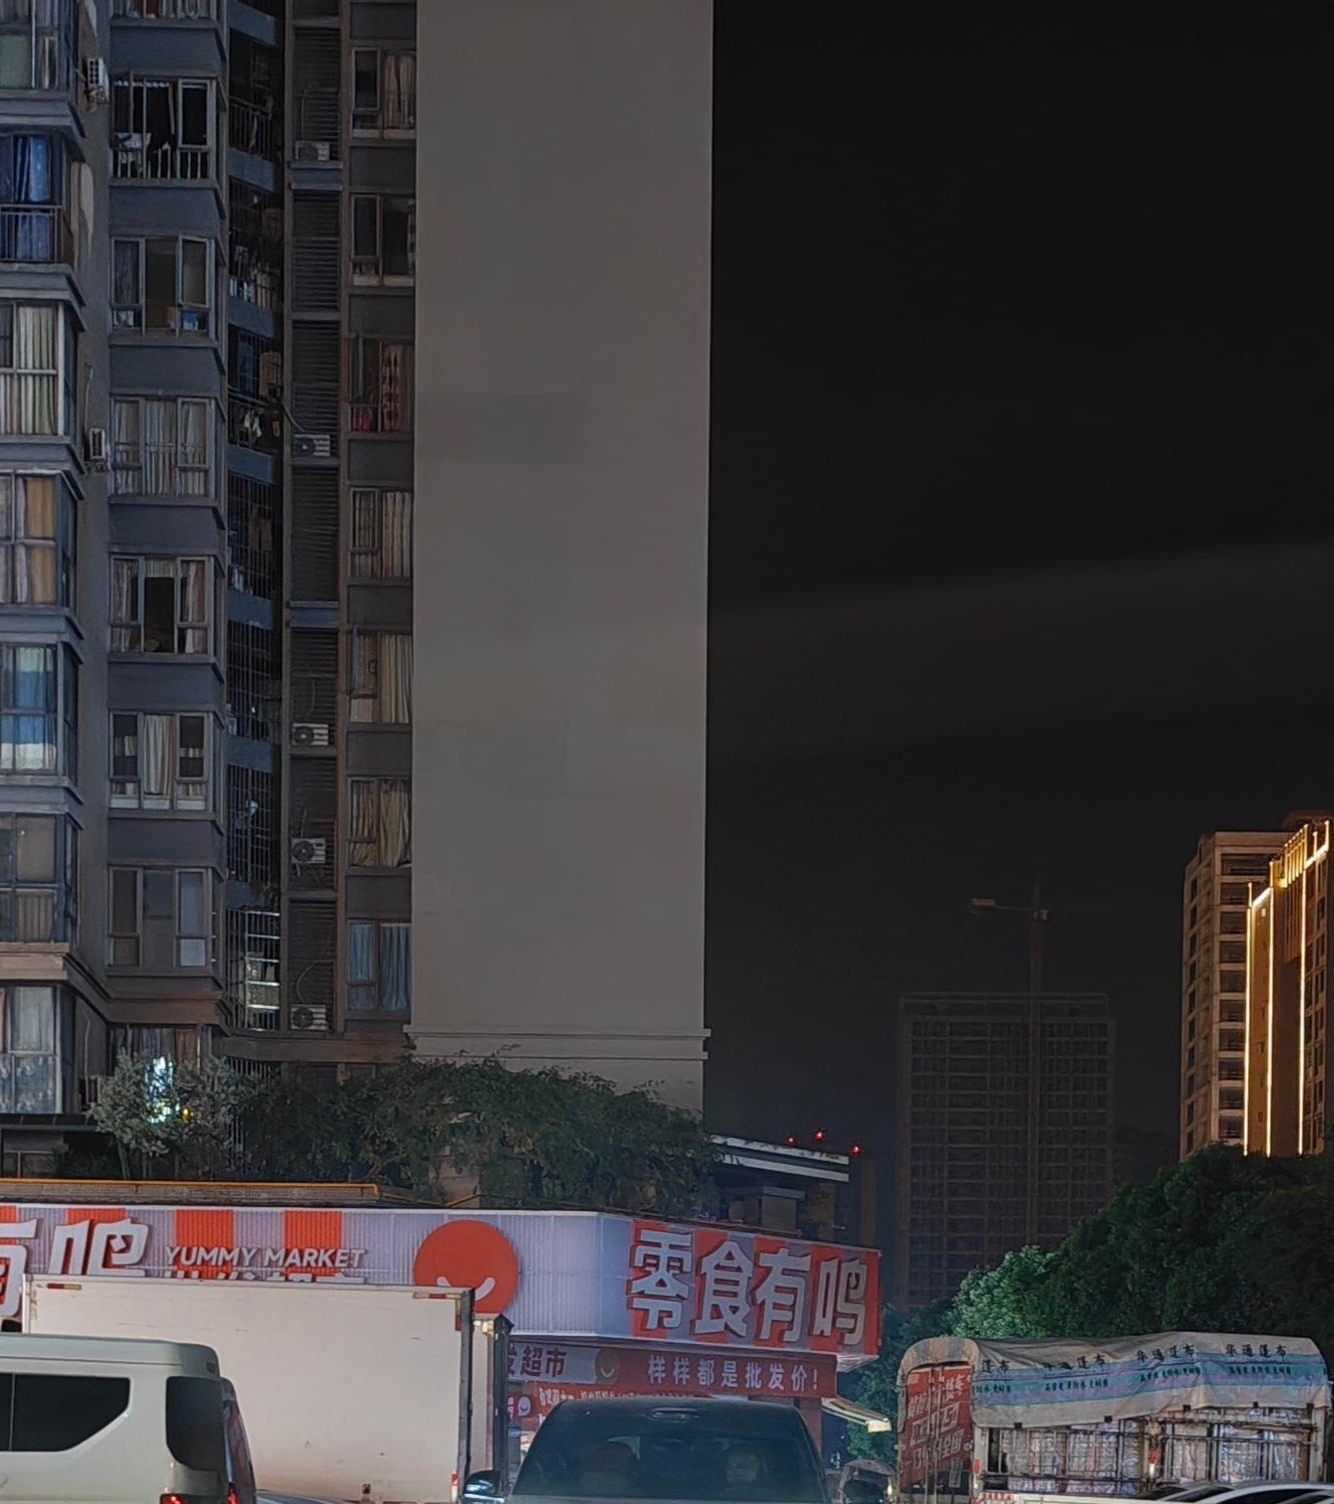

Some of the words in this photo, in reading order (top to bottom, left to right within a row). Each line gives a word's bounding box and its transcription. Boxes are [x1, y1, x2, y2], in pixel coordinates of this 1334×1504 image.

[166, 1246, 258, 1266] YUMMY
[264, 1248, 366, 1268] MARKET
[630, 1228, 868, 1346] 零食有鸣
